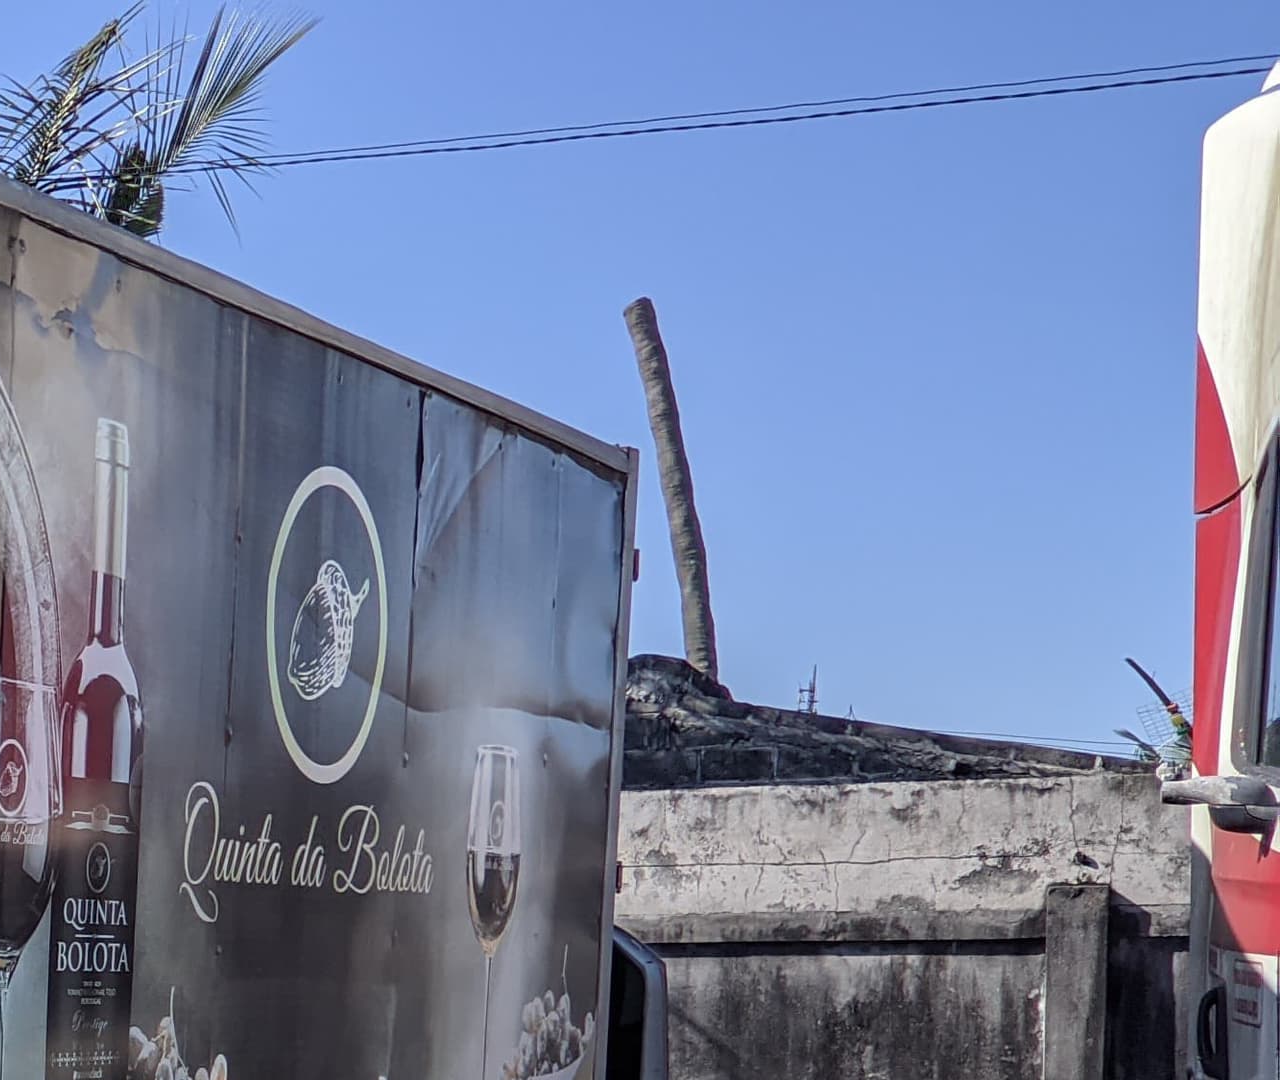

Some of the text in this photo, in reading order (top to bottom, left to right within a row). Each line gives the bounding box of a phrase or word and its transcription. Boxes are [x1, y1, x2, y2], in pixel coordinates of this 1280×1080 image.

[179, 781, 434, 922] Quinta da Bolota
[63, 897, 128, 930] QUINTA
[56, 941, 130, 972] BOLOTA
